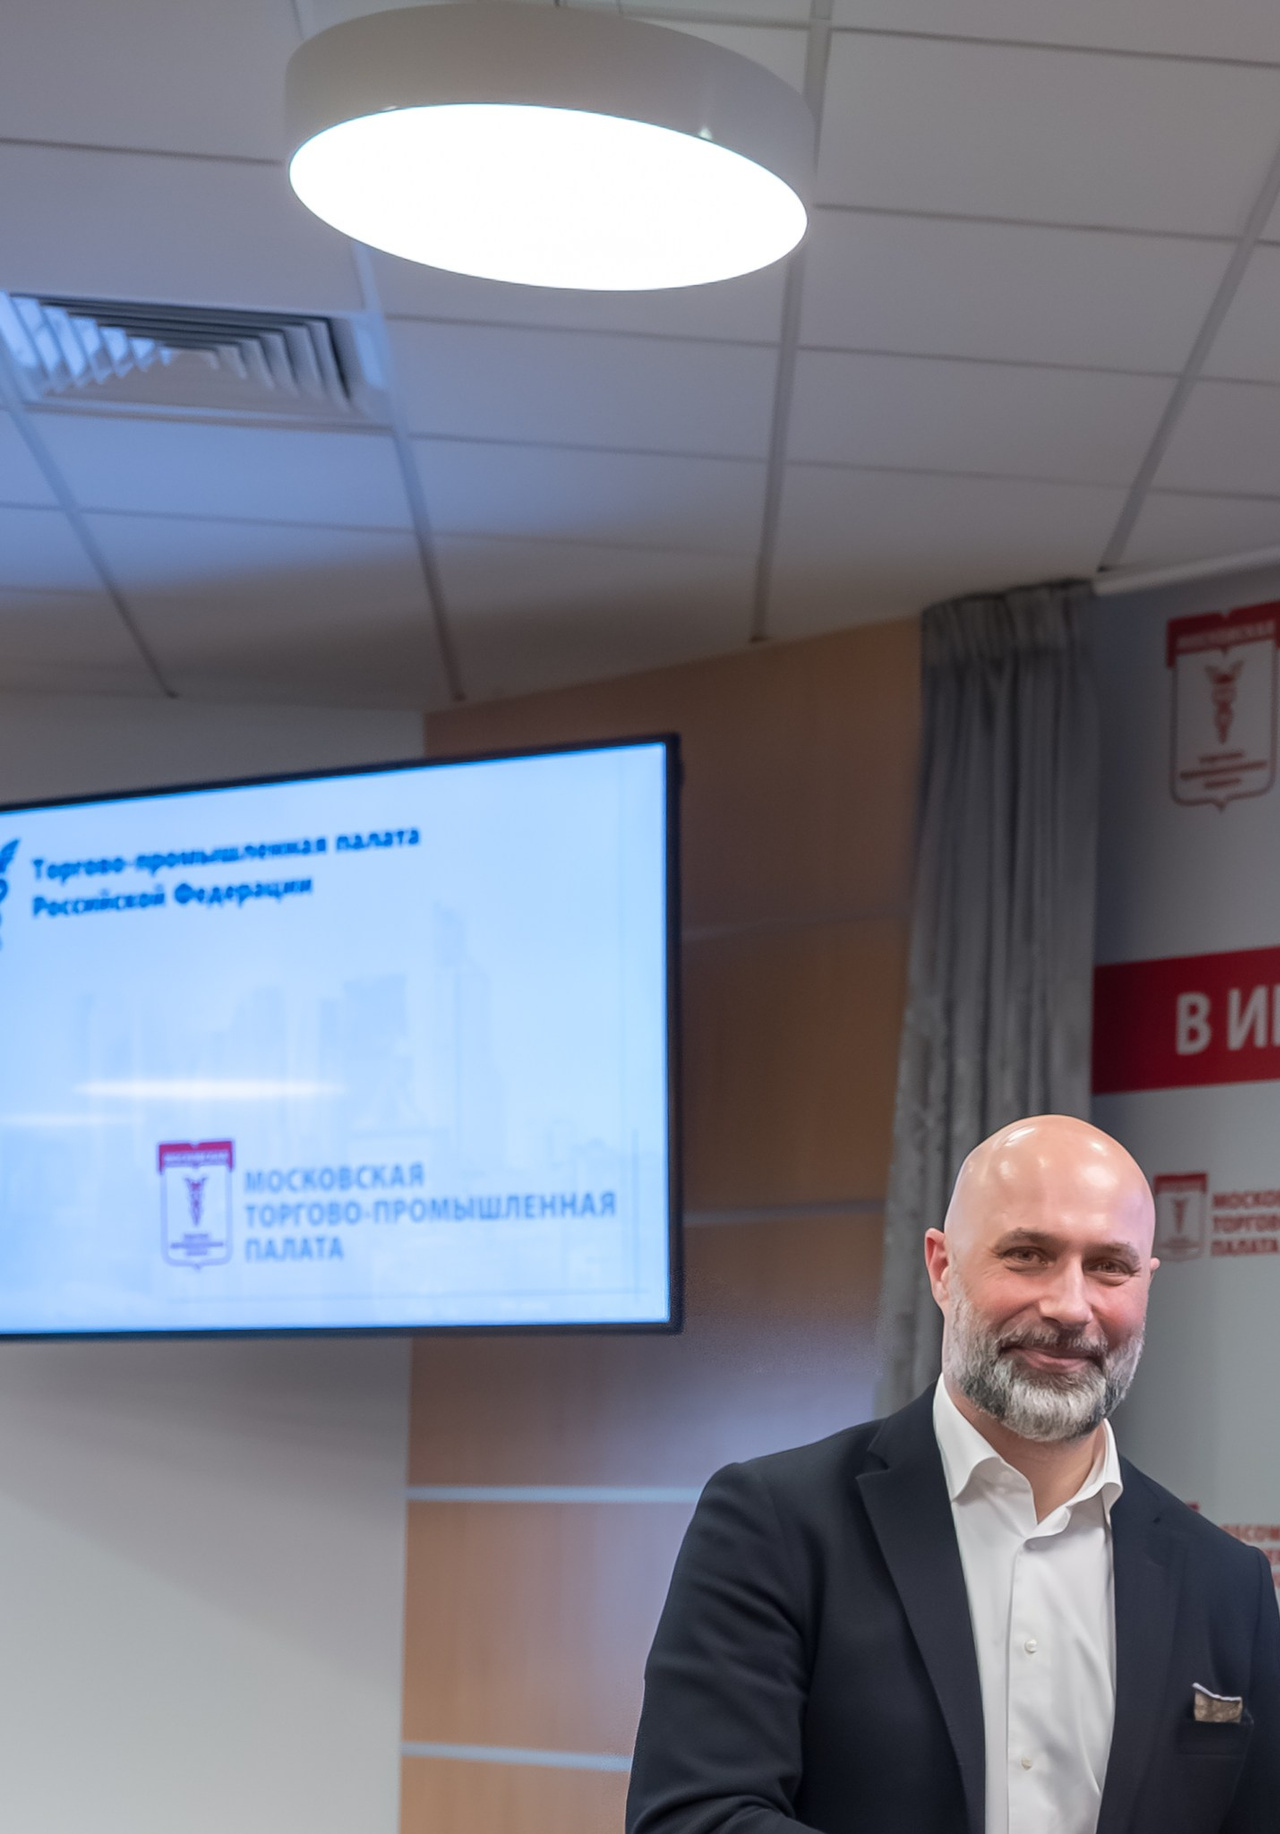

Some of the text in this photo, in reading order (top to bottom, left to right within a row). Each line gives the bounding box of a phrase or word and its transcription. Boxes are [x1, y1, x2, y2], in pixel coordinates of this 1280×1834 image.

[32, 827, 421, 883] Торгово-промышленная палата
[32, 878, 312, 918] Российской Федерации
[1175, 992, 1211, 1056] В
[244, 1162, 425, 1195] МОСКОВСКАЯ
[244, 1191, 617, 1227] ТОРГОВО-ПРОМЫШЛЕННАЯ
[244, 1234, 344, 1263] ПАЛАТА
